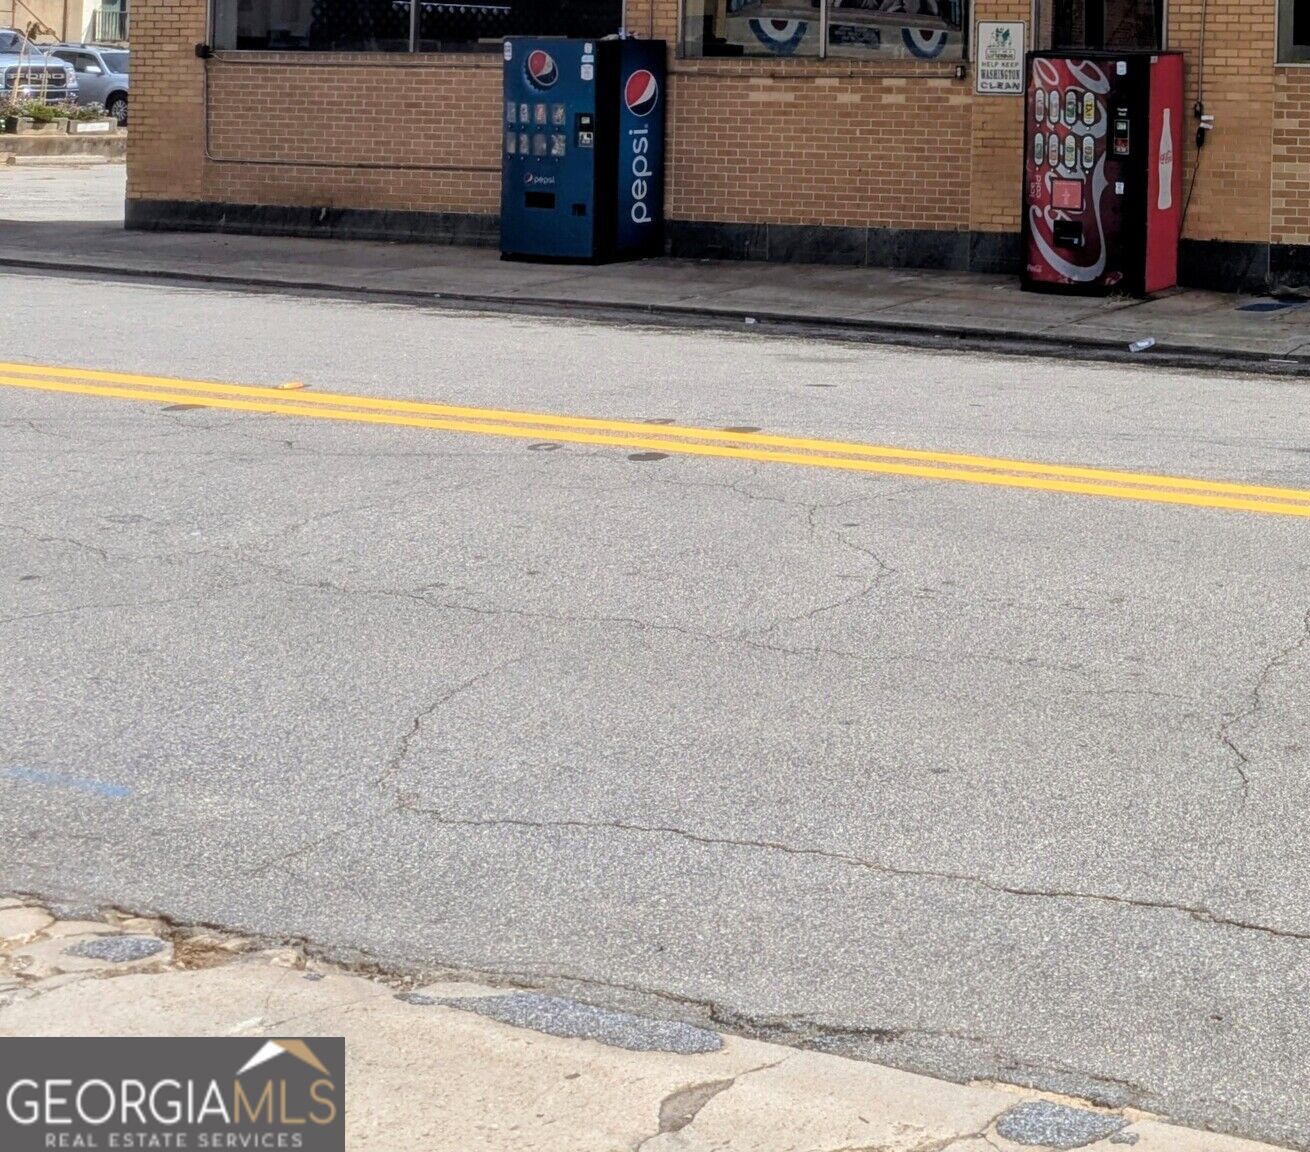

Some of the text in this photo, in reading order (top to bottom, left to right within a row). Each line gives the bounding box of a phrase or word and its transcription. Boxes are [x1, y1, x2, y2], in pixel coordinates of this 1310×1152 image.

[980, 69, 1021, 80] WASHINGTON
[980, 81, 1021, 90] CLEAN
[533, 176, 555, 184] pepsi
[629, 129, 652, 224] pepsi
